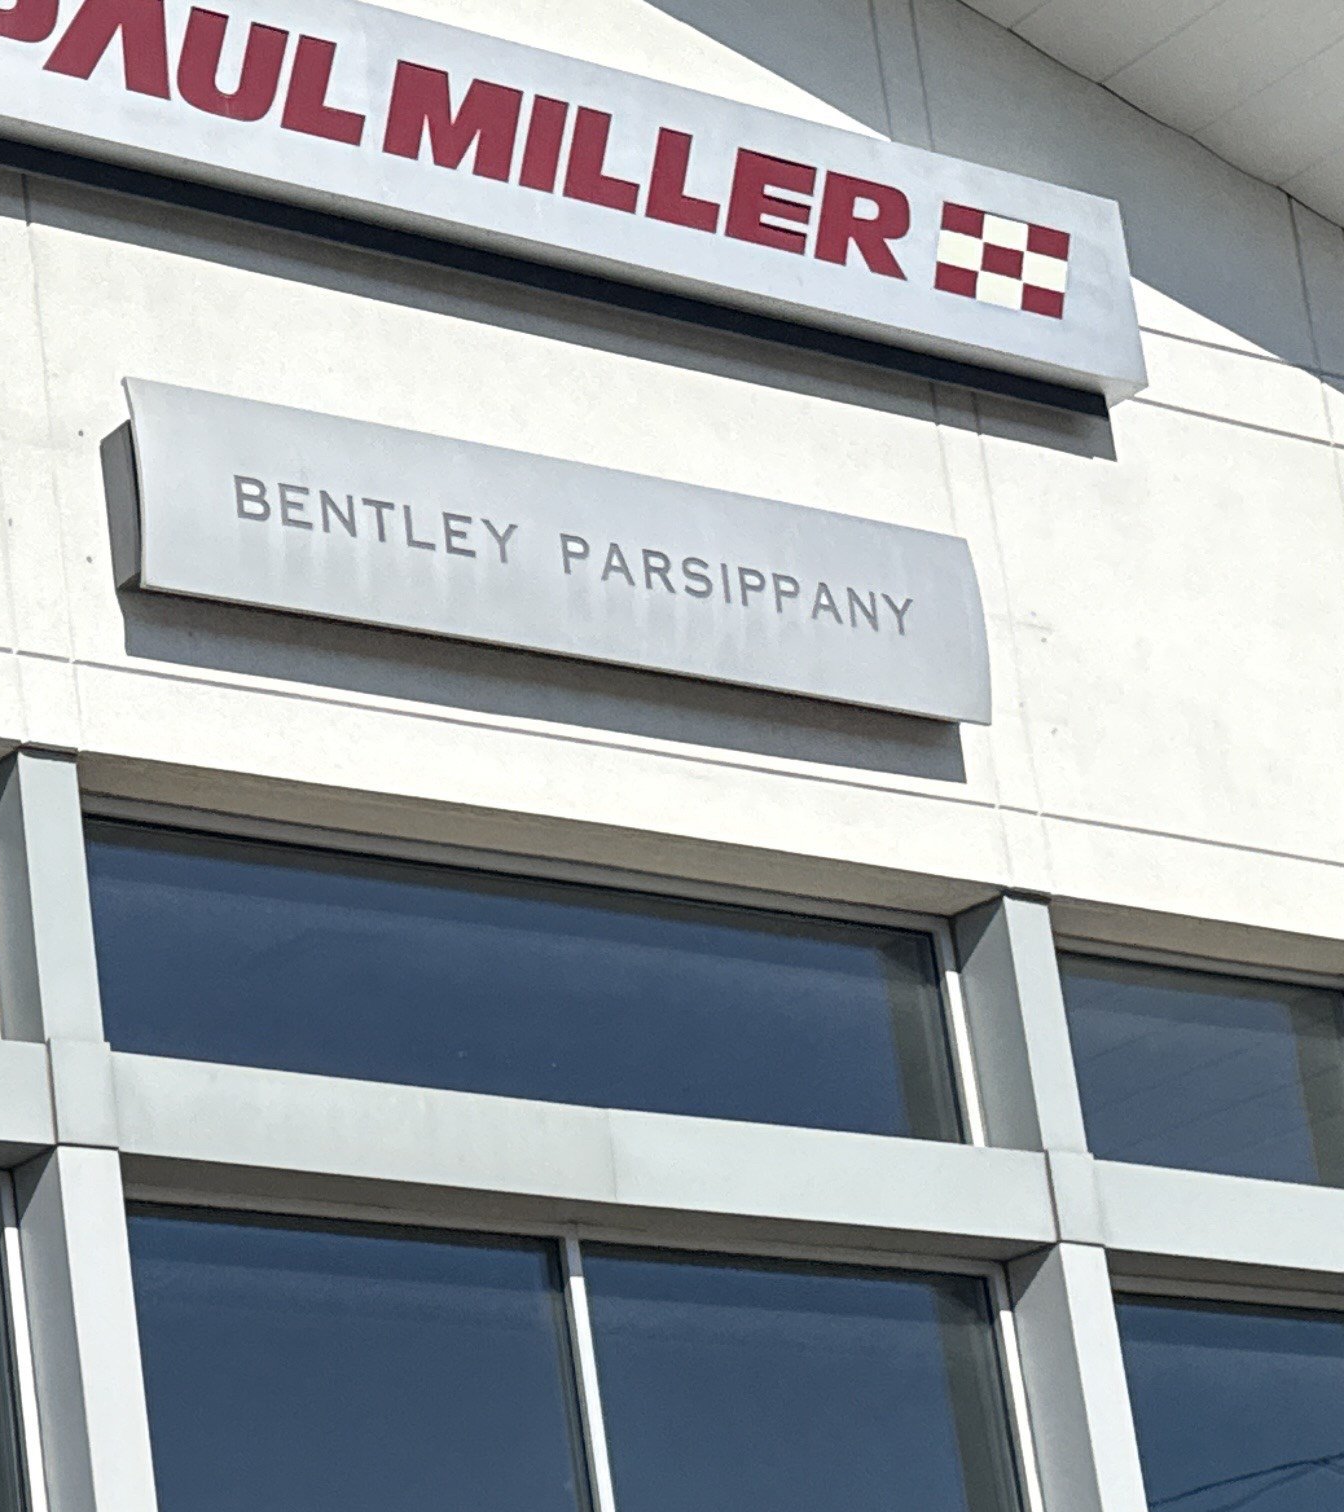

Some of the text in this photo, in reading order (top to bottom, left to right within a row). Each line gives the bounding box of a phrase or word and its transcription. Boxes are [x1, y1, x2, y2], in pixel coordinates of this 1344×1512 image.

[382, 59, 910, 281] MILLER
[233, 474, 913, 635] BENTLEY PARSIPPANY
